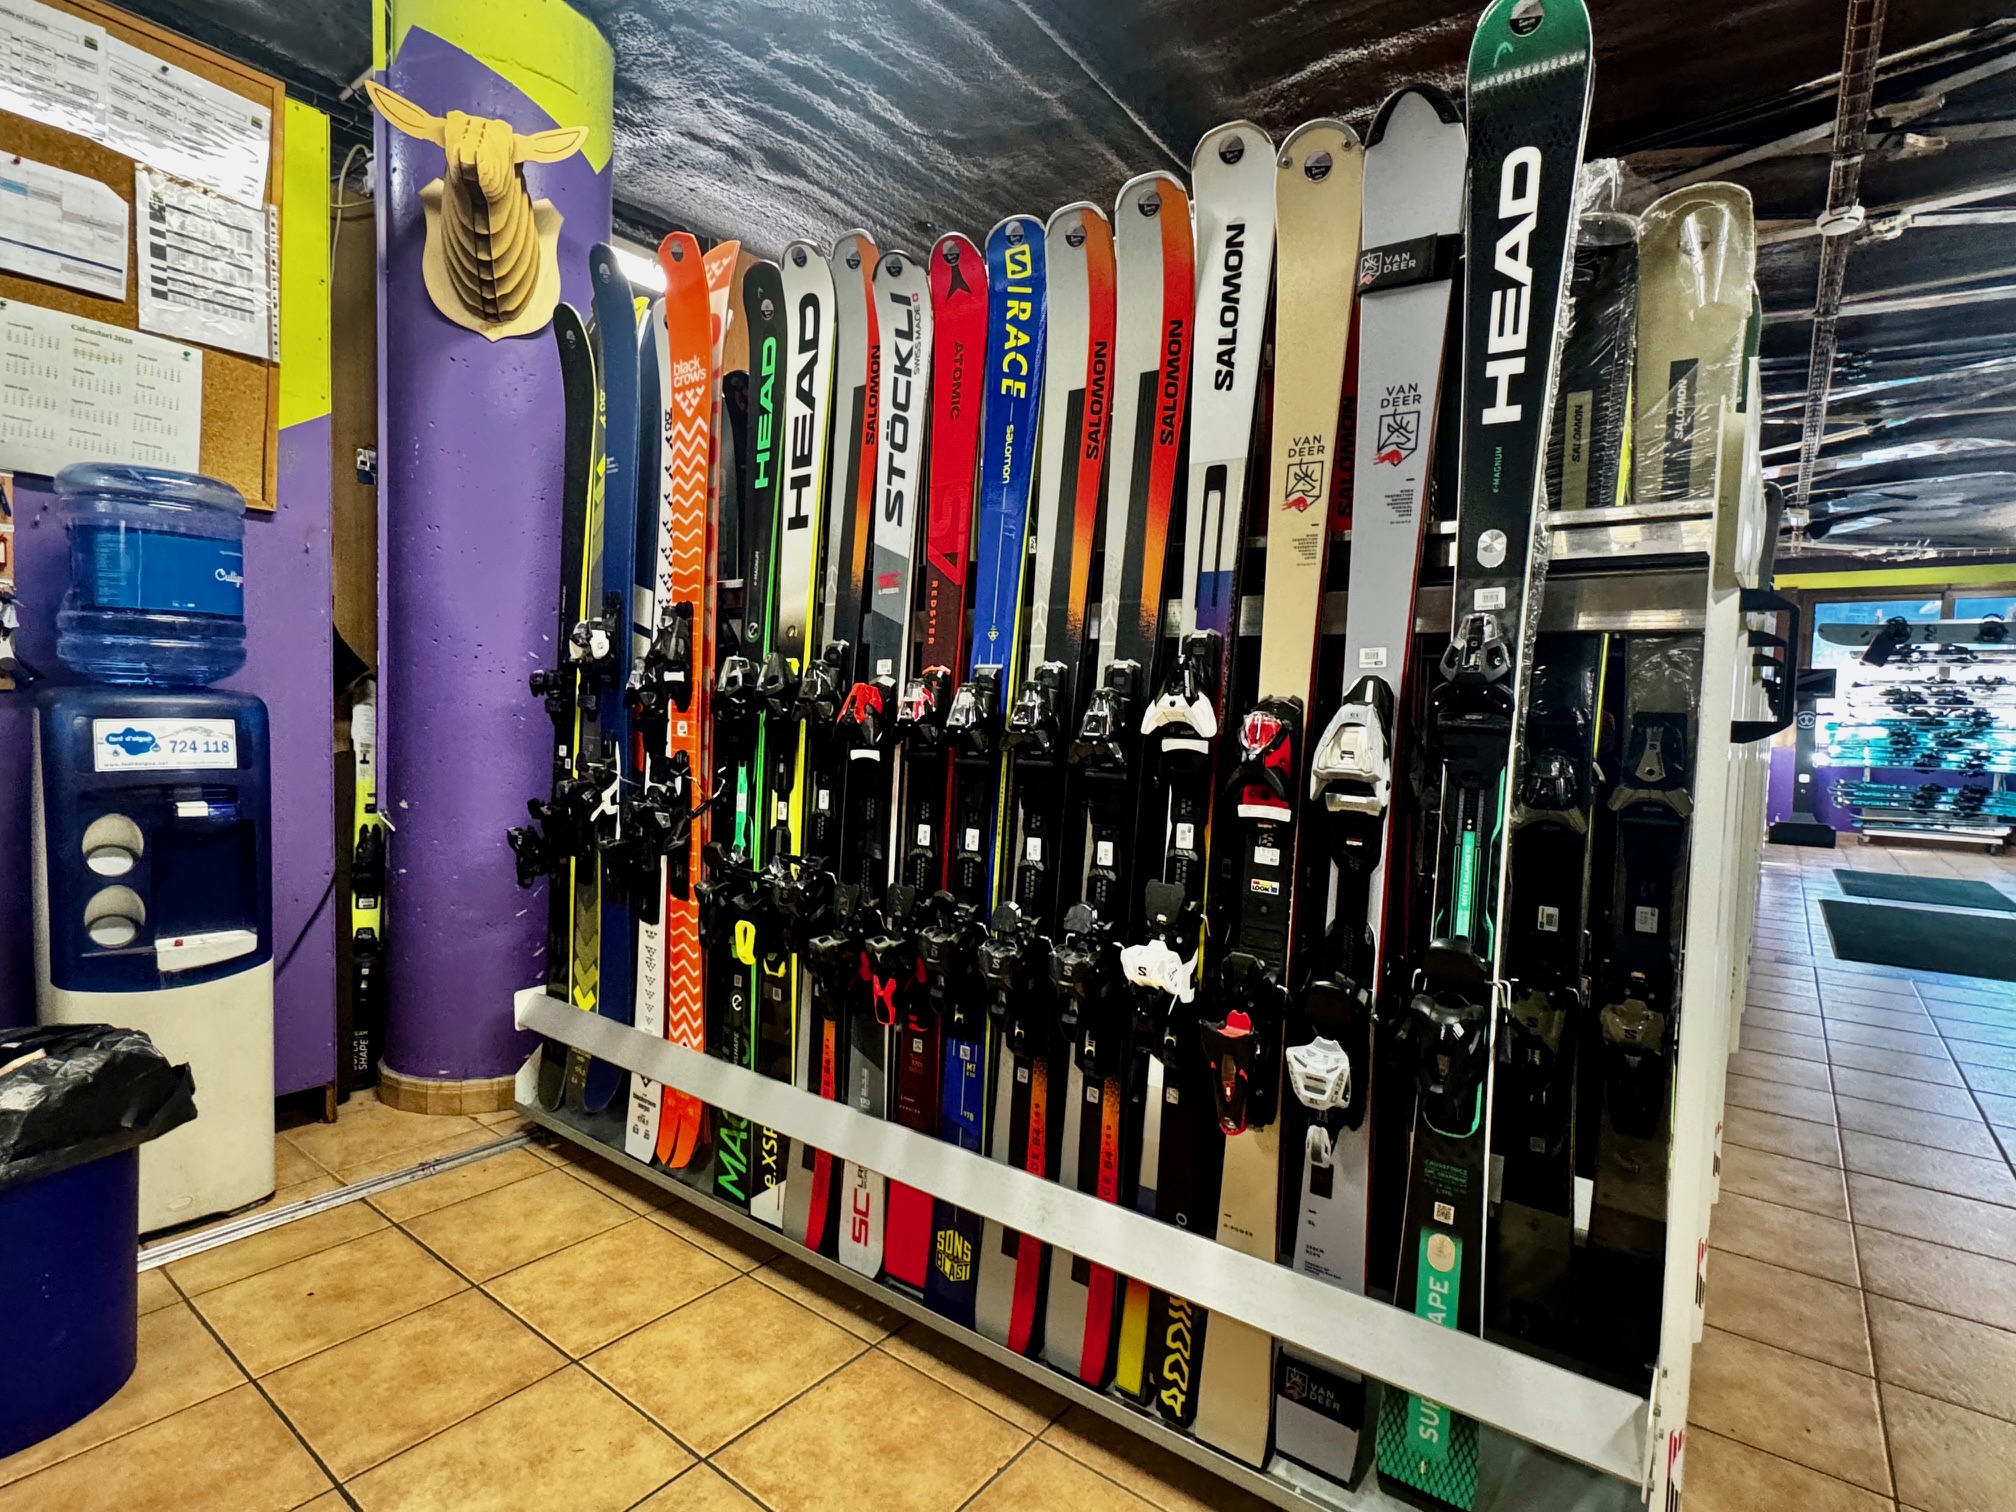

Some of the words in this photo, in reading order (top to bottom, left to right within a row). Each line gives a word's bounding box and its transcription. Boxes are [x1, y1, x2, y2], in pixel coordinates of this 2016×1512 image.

[1383, 252, 1411, 265] VAN
[1383, 258, 1417, 274] DEER
[1482, 145, 1542, 427] HEAD
[1214, 223, 1246, 392] SALOMON
[673, 355, 701, 377] black
[913, 343, 921, 375] SWISS
[673, 365, 707, 388] crows
[950, 341, 963, 420] ATOMIC
[1160, 319, 1183, 447] SALOMON
[1385, 383, 1420, 397] VAN
[866, 344, 881, 446] SALOMON
[884, 292, 913, 528] STÖCKLI
[1086, 340, 1108, 461] SALOMON
[1379, 393, 1423, 408] DEER
[1674, 379, 1688, 440] SALOMON
[754, 336, 777, 489] HEAD
[787, 292, 820, 532] HEAD
[1292, 434, 1324, 447] VAN
[1572, 405, 1583, 462] SALOMON
[1003, 424, 1014, 484] salomon
[1287, 444, 1326, 459] DEER
[929, 579, 939, 646] REDSTER
[169, 740, 198, 753] 724
[203, 740, 230, 753] 118
[358, 1039, 369, 1070] SHAPE
[852, 1188, 870, 1247] SC
[937, 1229, 972, 1262] SONS
[936, 1249, 971, 1282] BLAST
[1309, 1392, 1342, 1413] DEER
[1310, 1383, 1335, 1398] VAN
